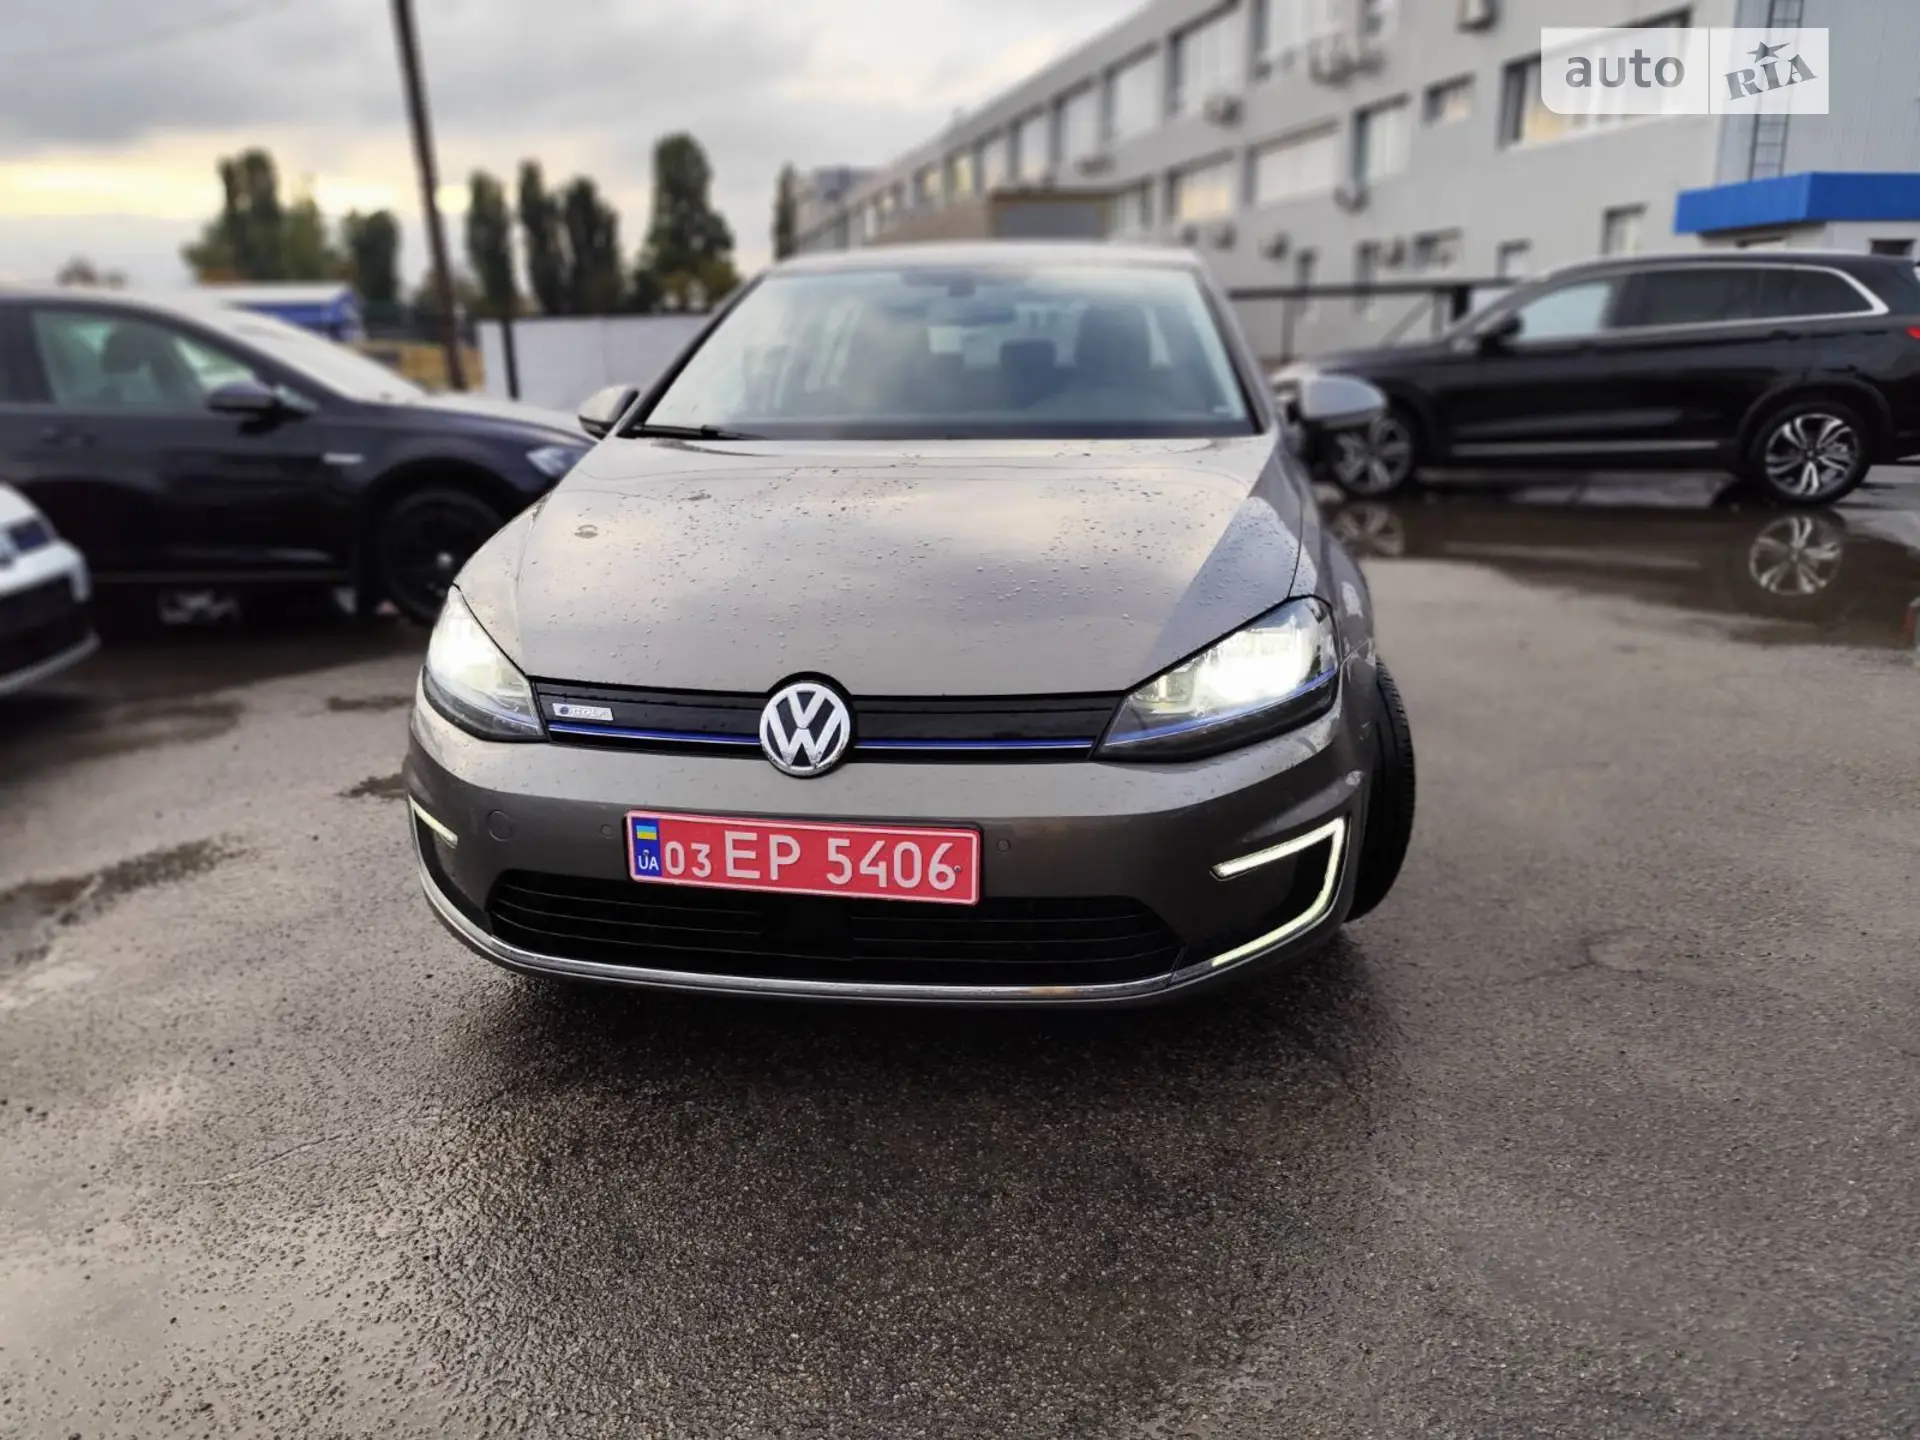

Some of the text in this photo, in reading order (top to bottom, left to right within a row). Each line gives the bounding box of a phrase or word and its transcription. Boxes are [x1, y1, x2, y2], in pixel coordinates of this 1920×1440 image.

[637, 852, 660, 871] UA
[665, 830, 956, 891] 03 EP 5406
